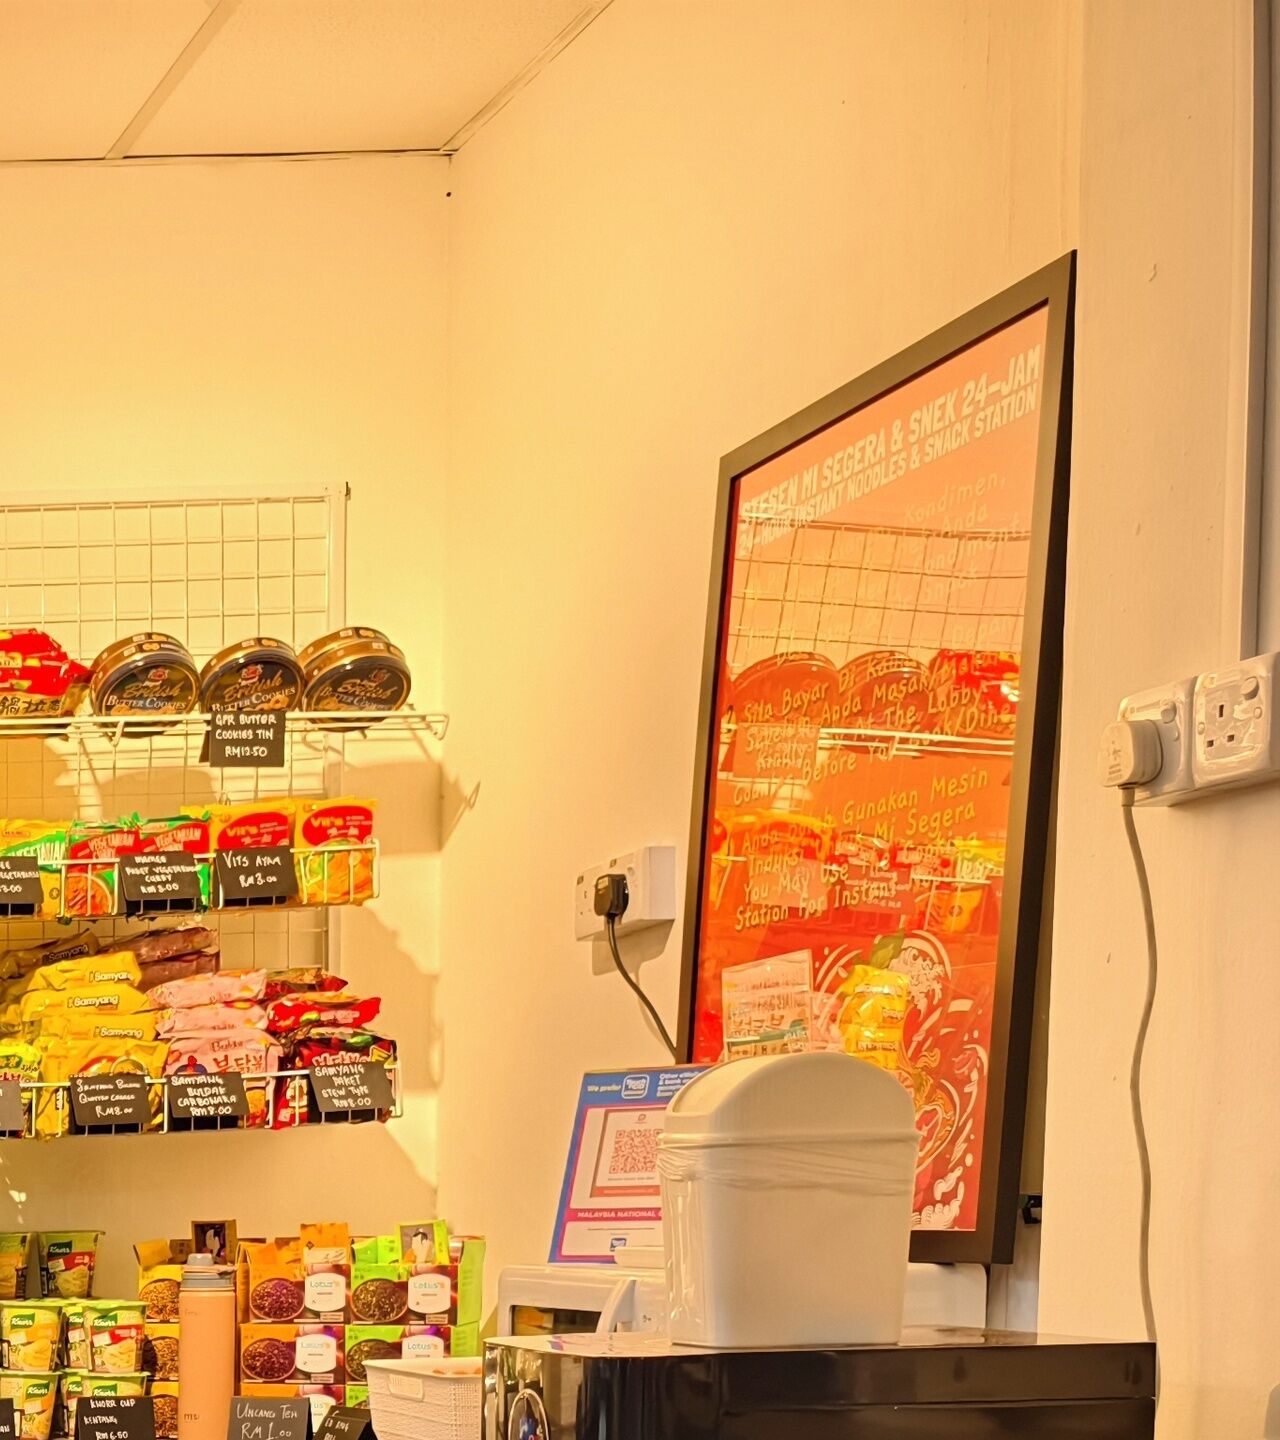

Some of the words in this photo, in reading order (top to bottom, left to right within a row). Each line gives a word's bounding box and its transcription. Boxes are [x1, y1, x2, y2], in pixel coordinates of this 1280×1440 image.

[802, 461, 820, 496] MI
[822, 427, 886, 489] SEGERA
[890, 419, 905, 451] &
[908, 395, 956, 444] SNEK
[962, 344, 1041, 414] 24-JAM
[847, 453, 907, 503] NOODLES
[910, 443, 921, 470] &
[923, 420, 971, 466] SNACK
[974, 384, 1037, 439] STATION
[106, 695, 144, 708] BUTTER
[146, 698, 186, 710] COOKIES
[252, 687, 296, 703] COOKIES
[783, 682, 828, 716] Bayar
[928, 684, 983, 714] Lobby
[215, 714, 236, 726] GPR
[256, 729, 274, 740] TIN
[843, 789, 918, 825] Gunakan
[931, 766, 987, 802] Mesin
[906, 801, 975, 842] Segera
[744, 880, 768, 904] You
[735, 905, 788, 931] Station
[74, 995, 118, 1007] Samyang
[314, 1064, 365, 1076] SAMYANG
[171, 1076, 224, 1086] SAMYANG
[11, 1317, 33, 1326] Knorr
[93, 1319, 116, 1328] Knorr
[27, 1385, 50, 1394] Knorr
[90, 1399, 117, 1408] KNORR
[120, 1399, 136, 1407] CUP
[241, 1423, 262, 1440] RM
